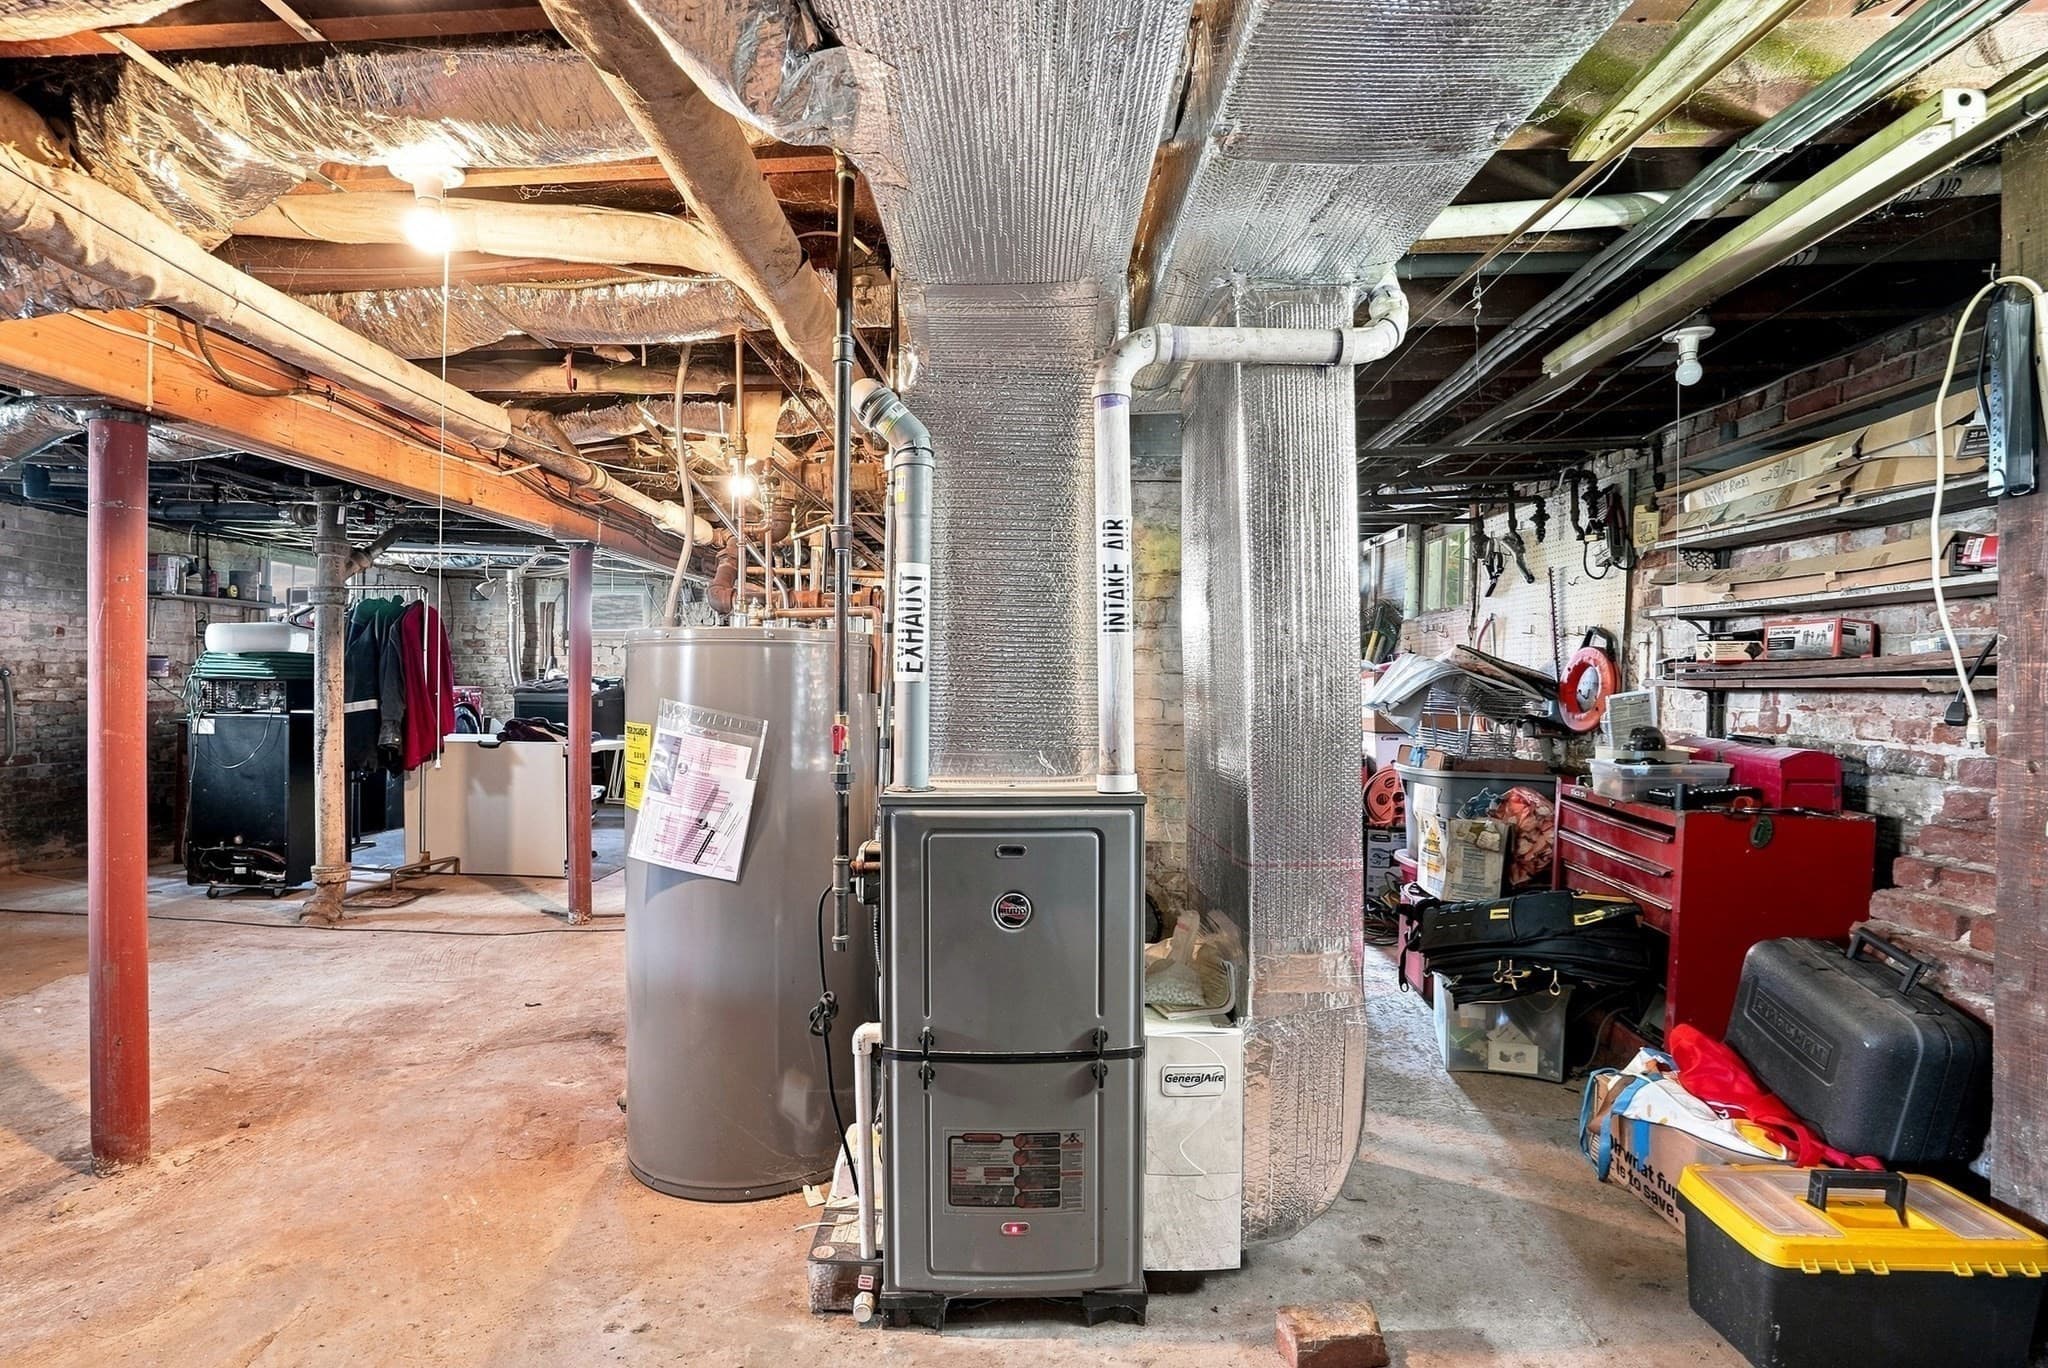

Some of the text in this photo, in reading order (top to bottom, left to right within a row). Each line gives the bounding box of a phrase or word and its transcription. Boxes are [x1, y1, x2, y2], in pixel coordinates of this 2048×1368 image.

[1102, 519, 1129, 633] INTAKE AIR
[897, 572, 926, 673] EXHAUST
[1164, 1072, 1225, 1084] GeneralAire
[1628, 1169, 1641, 1191] to
[1643, 1185, 1680, 1223] save.
